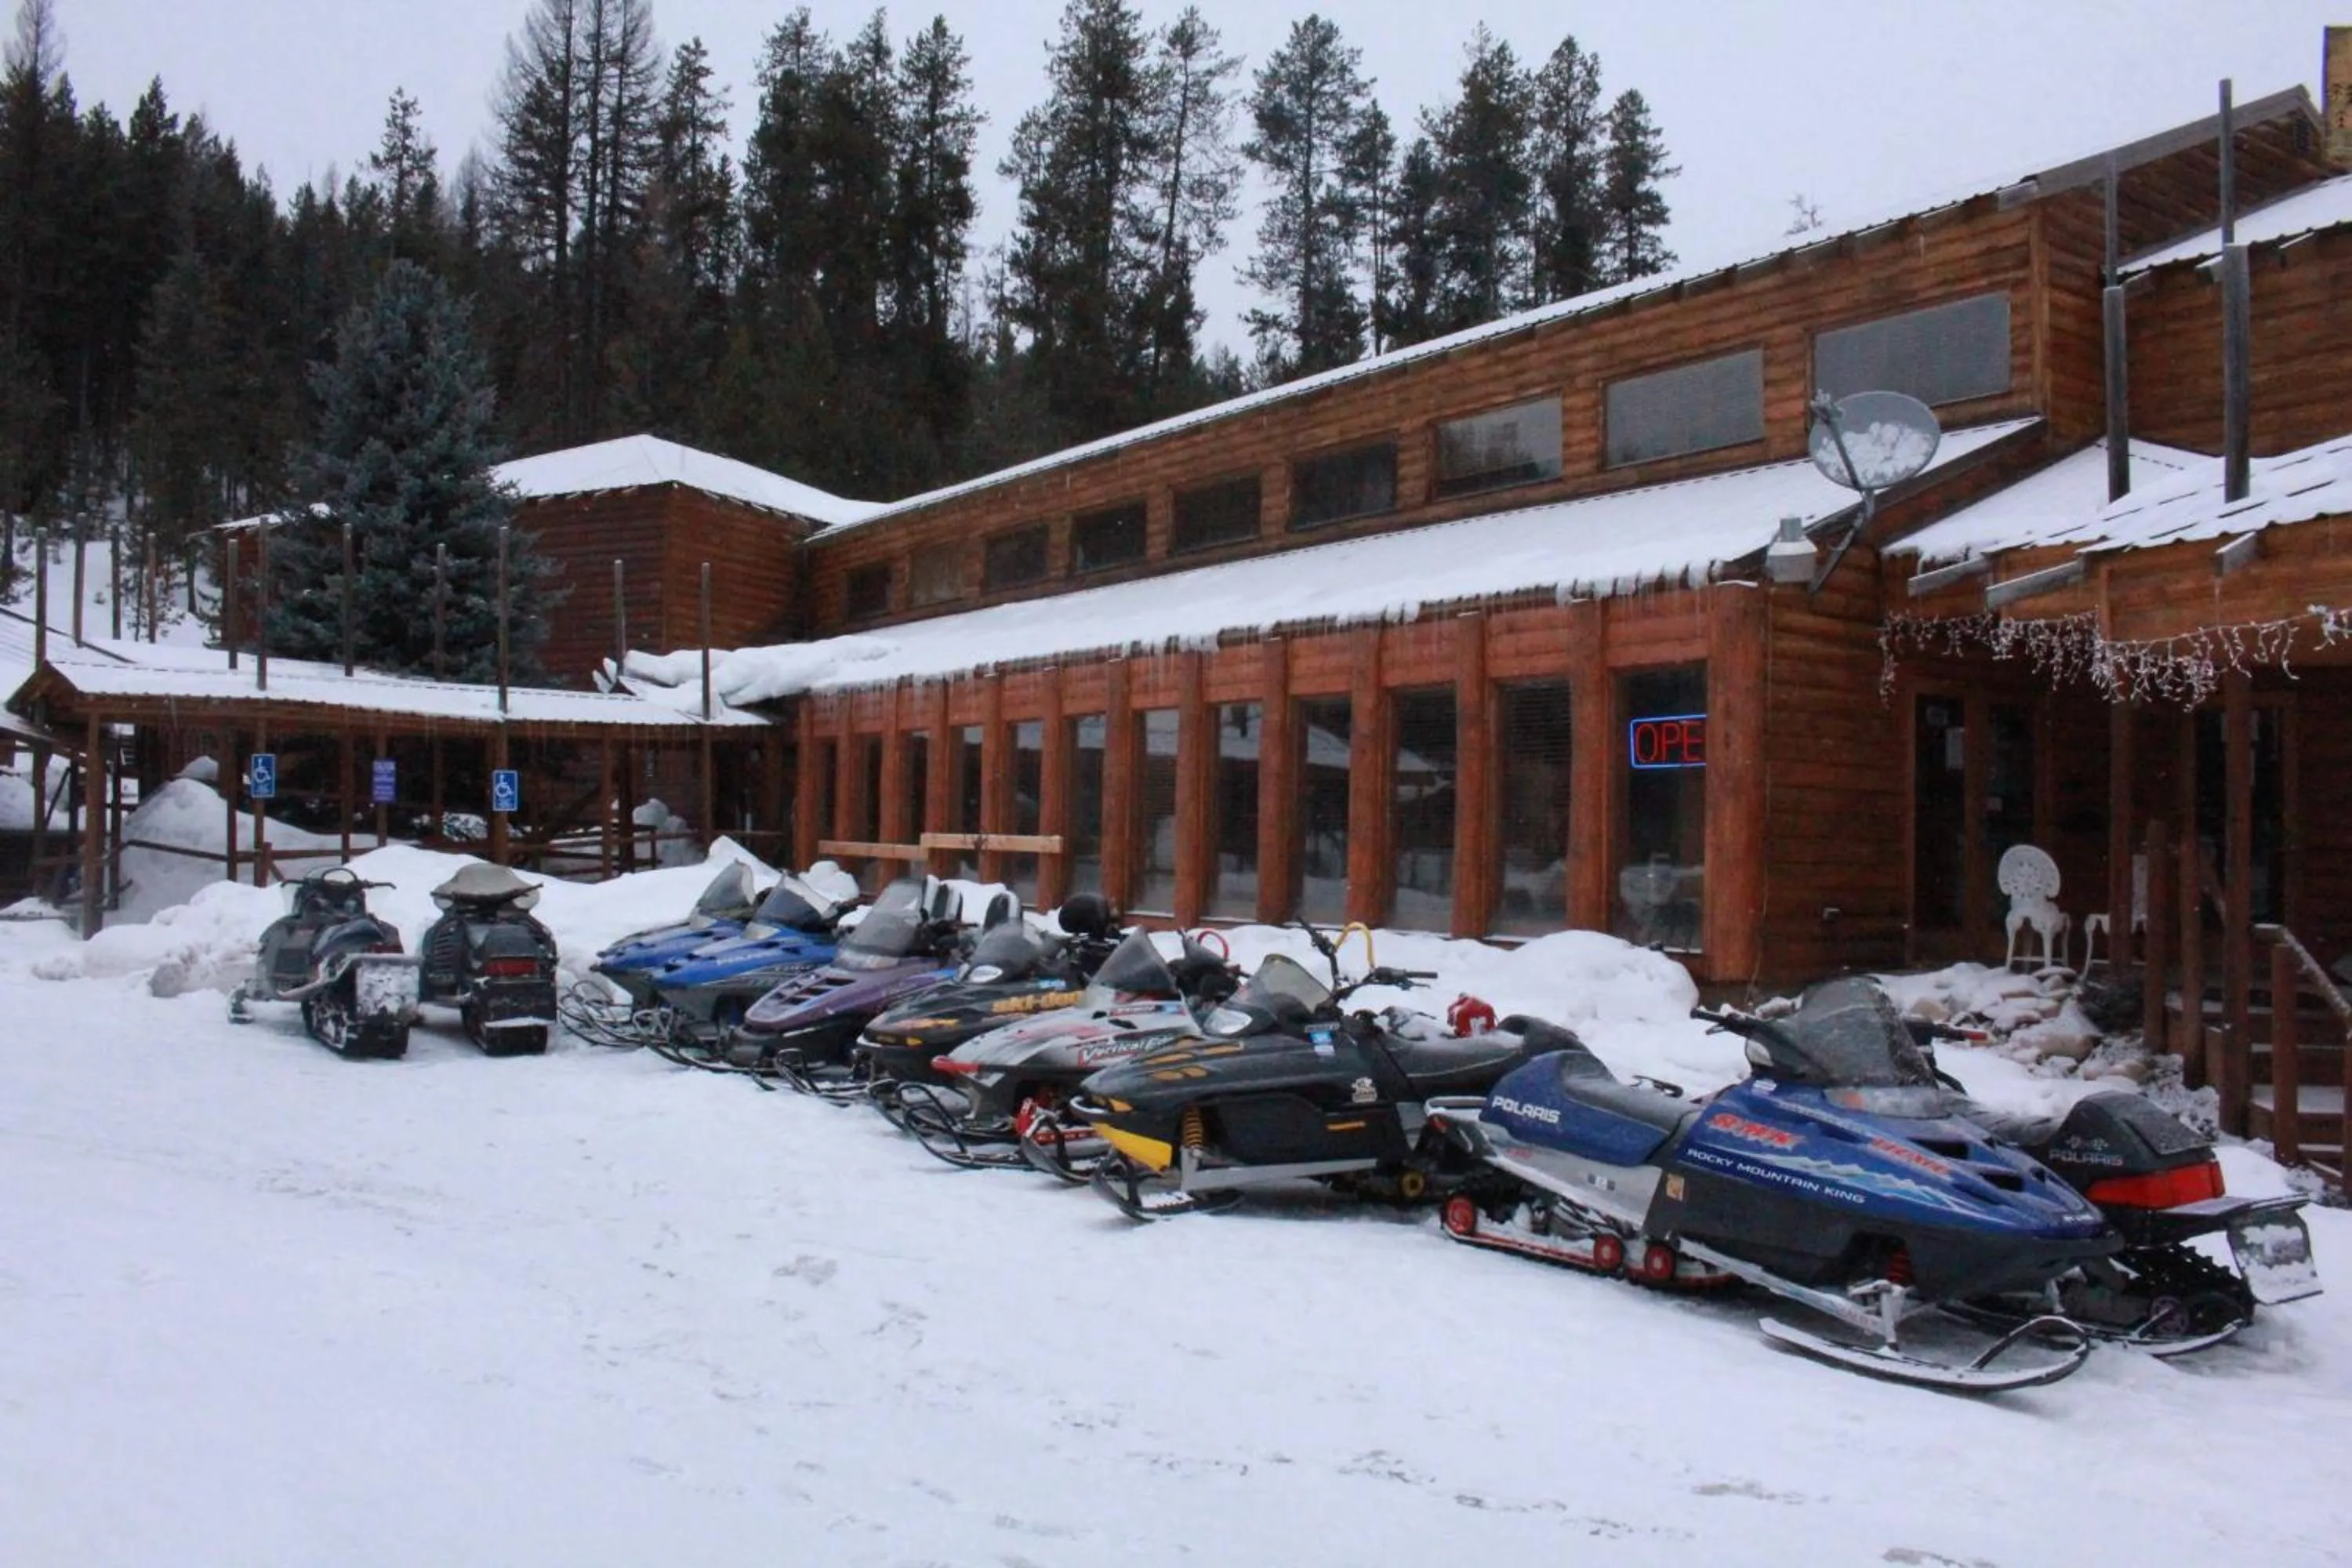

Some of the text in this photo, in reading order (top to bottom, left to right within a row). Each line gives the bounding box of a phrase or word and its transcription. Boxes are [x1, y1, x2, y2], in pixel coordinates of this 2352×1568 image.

[1635, 720, 1703, 764] OPE
[1492, 1094, 1561, 1123] POLARIS
[1687, 1148, 1866, 1204] ROCKY MOUNTAIN KING
[2049, 1149, 2124, 1167] POLARIS
